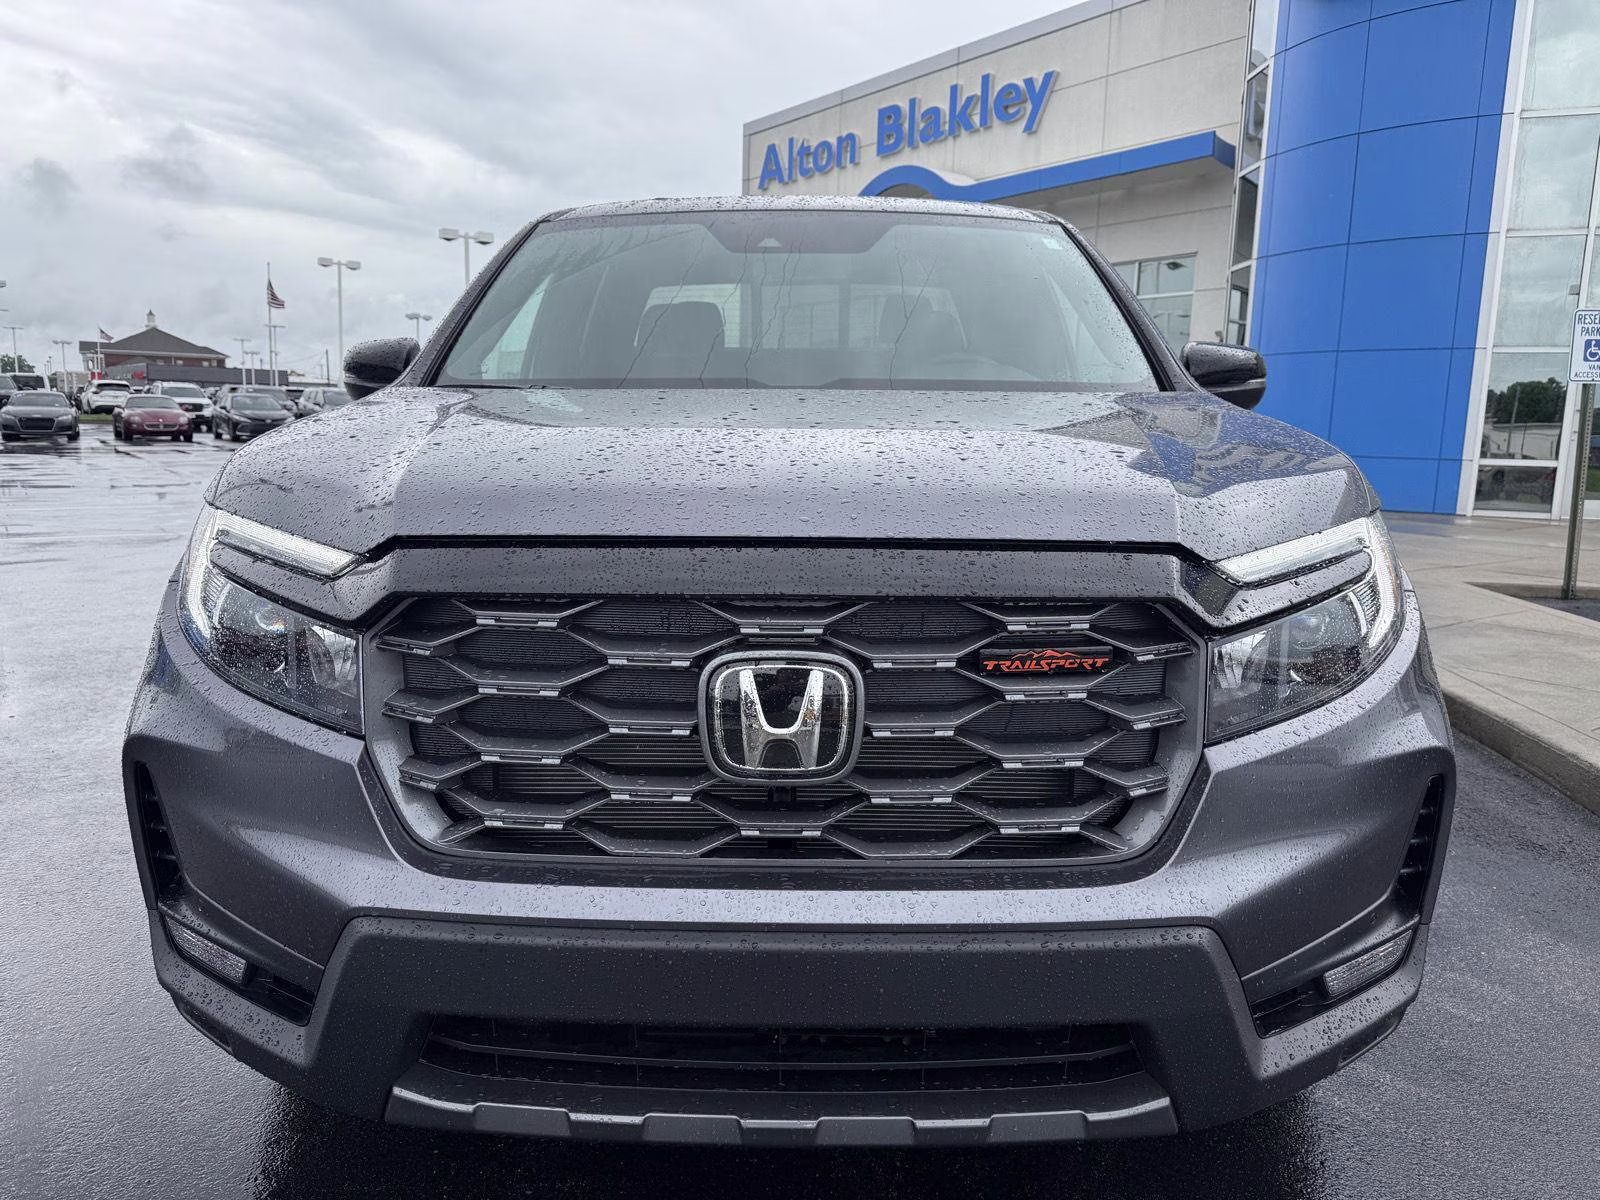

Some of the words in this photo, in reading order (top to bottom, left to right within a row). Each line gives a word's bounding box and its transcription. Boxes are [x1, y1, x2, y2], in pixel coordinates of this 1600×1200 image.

[758, 131, 860, 191] Alton
[876, 70, 1060, 158] Blakley
[1577, 313, 1600, 325] RESE
[983, 657, 1109, 672] TRAILSPORT
